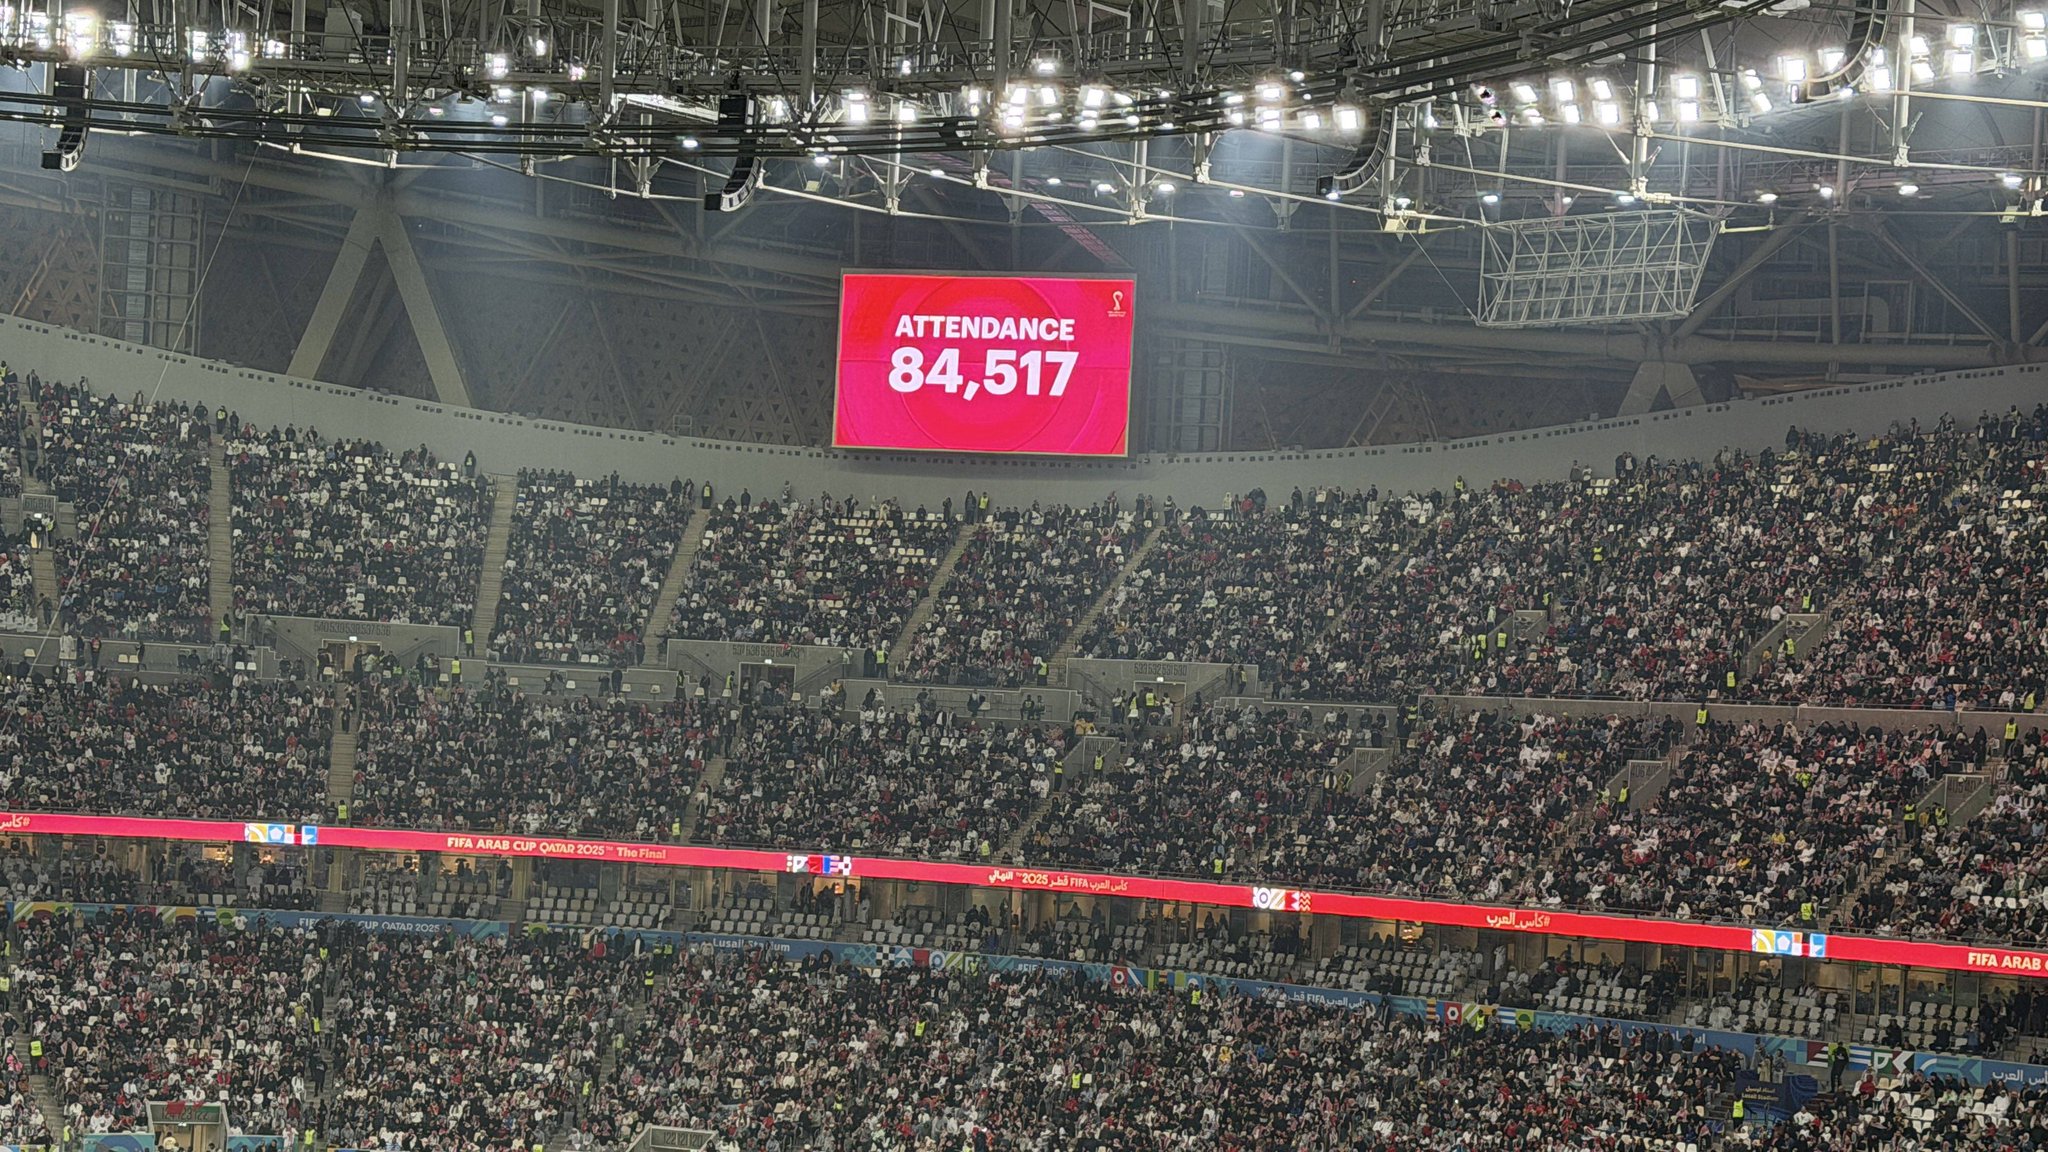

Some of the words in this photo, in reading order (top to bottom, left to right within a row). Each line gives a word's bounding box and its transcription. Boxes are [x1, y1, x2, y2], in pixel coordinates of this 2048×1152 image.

[895, 314, 1075, 341] ATTENDANCE
[888, 346, 1079, 401] 84,517
[447, 837, 473, 848] FIFA
[476, 838, 510, 850] ARAB
[513, 840, 536, 851] CUP
[539, 842, 575, 854] QATAR
[617, 847, 638, 858] The
[639, 848, 666, 859] Final
[1049, 875, 1068, 887] قطر
[1070, 877, 1088, 888] FIFA
[1090, 880, 1110, 891] العرب
[381, 921, 413, 932] QATAR
[416, 923, 440, 933] 2025
[712, 938, 744, 949] Lusail
[1968, 952, 1998, 967] FIFA
[2001, 955, 2041, 970] ARAB
[1307, 993, 1325, 1003] FIFA
[663, 1132, 676, 1145] 122
[677, 1133, 688, 1146] 121
[690, 1133, 703, 1147] 120
